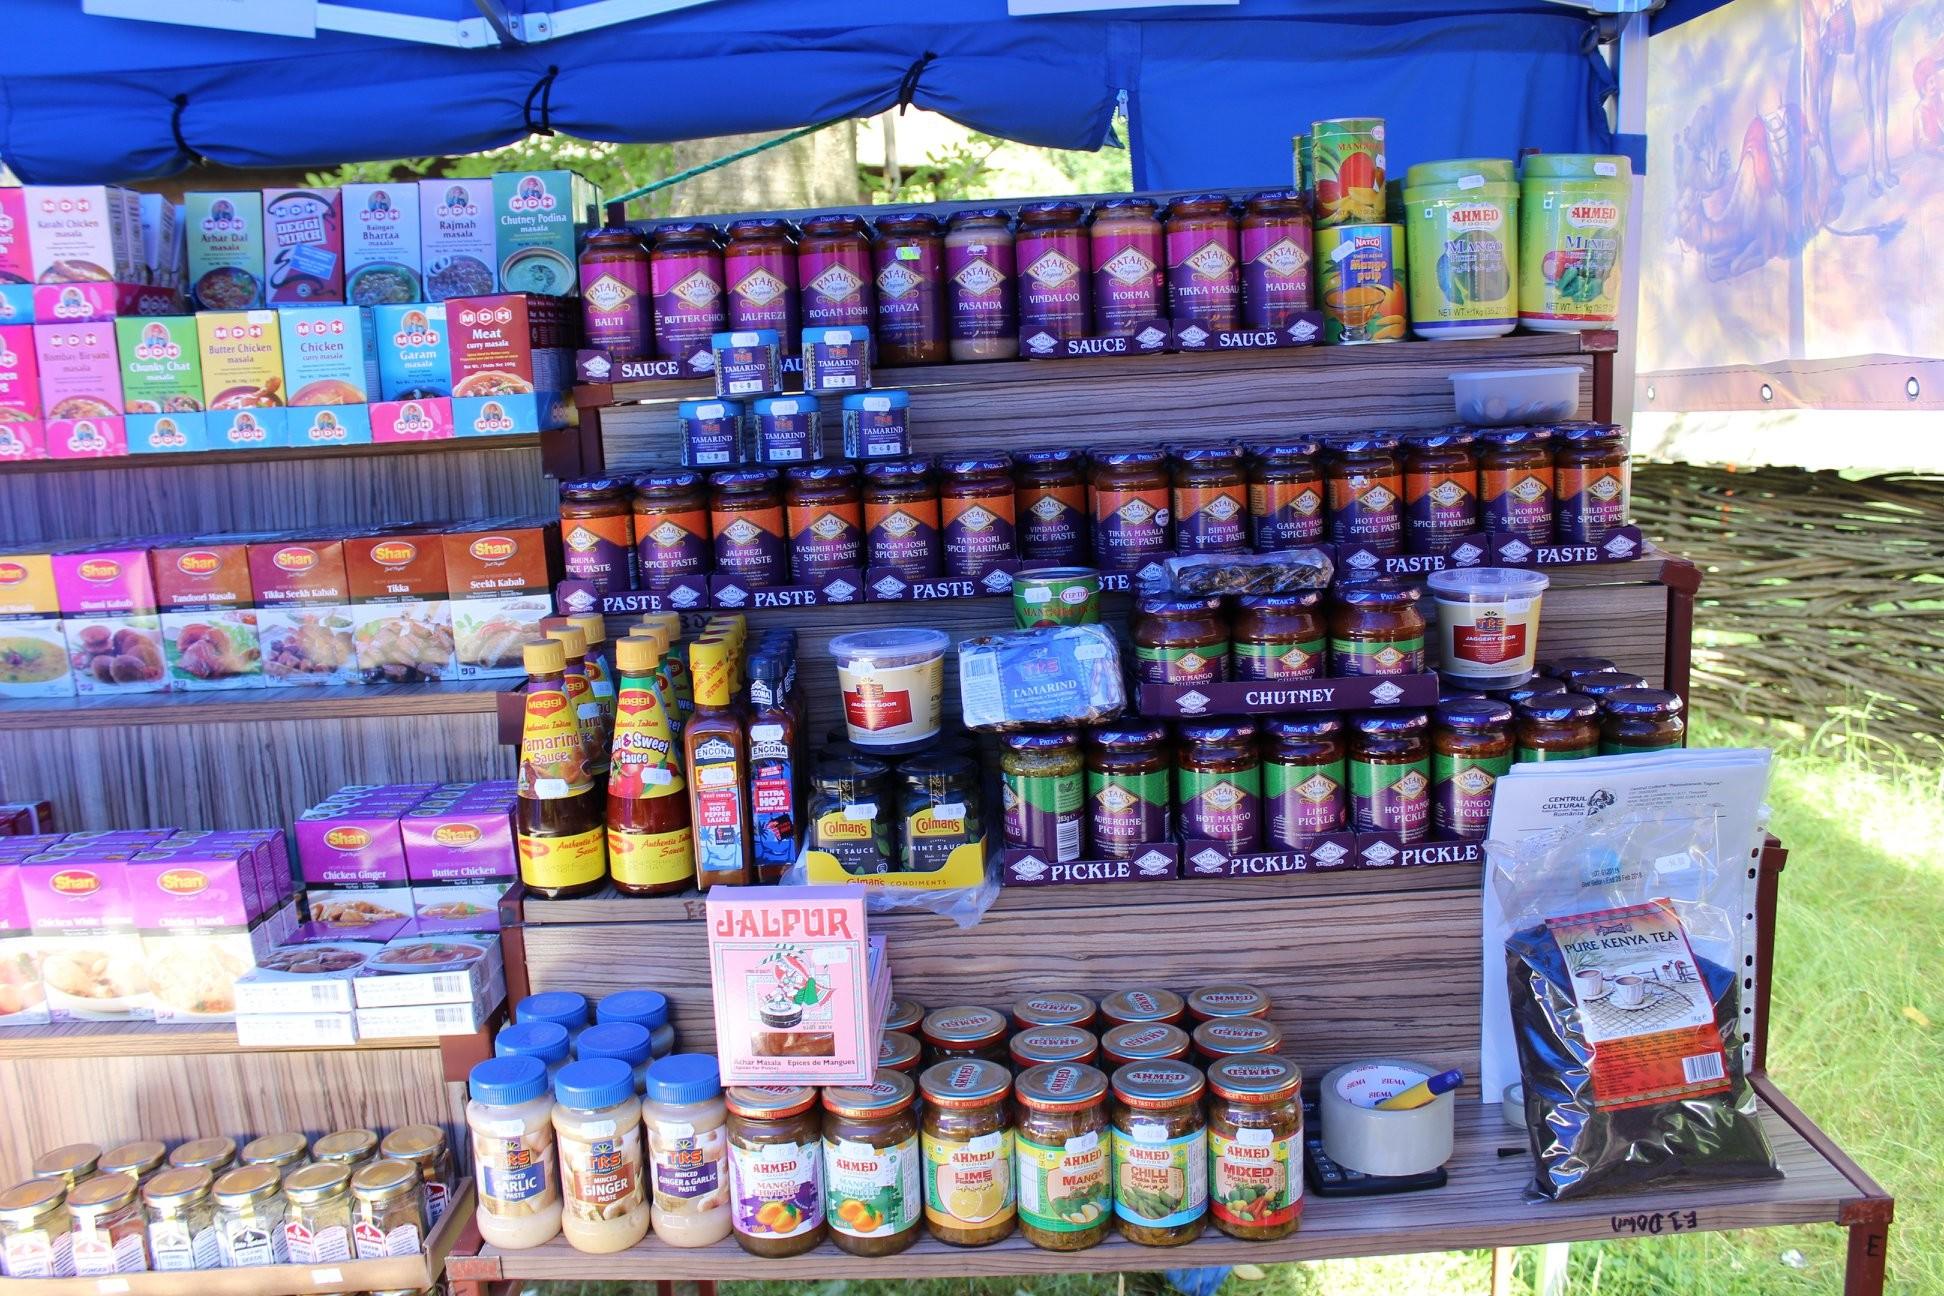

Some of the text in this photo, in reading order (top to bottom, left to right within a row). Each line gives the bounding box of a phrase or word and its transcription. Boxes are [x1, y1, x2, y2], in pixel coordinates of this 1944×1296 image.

[511, 197, 554, 209] MDH
[437, 205, 478, 216] MDH
[1452, 208, 1498, 222] AHMED
[1571, 207, 1617, 219] AHMED
[276, 219, 321, 233] DEGGI
[501, 214, 567, 226] Chutney Podina
[439, 221, 477, 233] Rajmah
[201, 233, 228, 243] Arhar
[278, 231, 322, 246] MIRCH
[363, 231, 400, 240] Bhartaa
[1355, 238, 1380, 248] NATCO
[1566, 236, 1617, 250] MIXED
[1351, 260, 1387, 272] Mango
[1357, 271, 1382, 283] pulp
[1265, 282, 1307, 292] MADRAS
[1029, 293, 1080, 304] VINDALOO
[1113, 290, 1150, 300] KORMA
[879, 303, 919, 313] DOPIAZA
[959, 301, 1002, 311] PASANDA
[461, 309, 511, 325] MDH
[741, 312, 786, 322] JALFREZI
[809, 307, 868, 319] ROGAN JOSH
[297, 321, 345, 335] MDH
[595, 317, 624, 327] BALTI
[215, 326, 263, 338] MDH
[472, 329, 501, 340] Meat
[396, 333, 438, 345] MDH
[1219, 332, 1278, 347] SAUCE
[300, 342, 344, 353] Chicken
[1068, 338, 1127, 354] SAUCE
[400, 351, 437, 361] Garam
[622, 361, 680, 377] SAUCE
[764, 431, 806, 440] TAMARIND
[863, 426, 903, 435] TAMARIND
[692, 435, 733, 444] TAMARIND
[1436, 511, 1460, 519] TIKKA
[1515, 507, 1544, 515] KORMA
[1108, 528, 1164, 538] TIKKA MASALA
[957, 535, 1000, 544] TANDOORI
[1109, 536, 1164, 547] SPICE PASTE
[375, 548, 412, 562] Shan
[475, 543, 512, 557] Shan
[725, 549, 762, 557] JALFREZI
[796, 545, 834, 553] KASHMIRI
[875, 548, 928, 559] SPICE PASTE
[1537, 547, 1599, 563] PASTE
[277, 553, 312, 567] Shan
[719, 556, 772, 566] SPICE PASTE
[803, 550, 857, 562] SPICE PASTE
[182, 556, 217, 570] Shan
[644, 558, 698, 569] SPICE PASTE
[1386, 556, 1446, 572] PASTE
[387, 584, 410, 593] Tikka
[470, 578, 525, 589] Seekh Kabab
[913, 581, 975, 598] PASTE
[172, 592, 237, 603] Tandoori Masala
[755, 590, 816, 607] PASTE
[603, 596, 661, 612] PASTE
[1170, 672, 1213, 682] HOT MANGO
[1273, 668, 1315, 679] HOT MANGO
[1012, 680, 1077, 698] TAMARIND
[1245, 688, 1335, 706] CHUTNEY
[527, 698, 562, 710] Maggi
[551, 720, 572, 730] Indian
[637, 719, 659, 729] Indian
[523, 733, 580, 750] Tamarind
[697, 747, 734, 758] ENCONA
[753, 746, 786, 756] ENCONA
[533, 752, 568, 764] Sauce
[621, 752, 649, 764] Sauce
[760, 797, 785, 807] HOT
[1455, 799, 1491, 808] MANGO
[1306, 807, 1328, 815] LIME
[1453, 808, 1492, 817] PICKLE
[1095, 815, 1141, 826] AUBERGINE
[1196, 812, 1250, 823] HOT MANGO
[1298, 815, 1335, 826] PICKLE
[824, 821, 867, 837] Colman's
[916, 817, 960, 834] Colman's
[1098, 826, 1135, 836] PICKLE
[1205, 823, 1243, 833] PICKLE
[328, 832, 367, 846] Shan
[436, 829, 475, 842] Shan
[557, 838, 592, 851] Authentic
[641, 838, 676, 850] Authentic
[1401, 844, 1479, 866] PICKLE
[1231, 854, 1307, 876] PICKLE
[323, 870, 386, 882] Chicken Ginger
[432, 867, 496, 878] Butter Chicken
[1051, 862, 1131, 881] PICKLE
[890, 879, 947, 887] CONDIMENTS
[716, 908, 853, 939] JALPUR
[1564, 931, 1678, 954] PURE KENYA TEA
[788, 1059, 811, 1068] Epices
[824, 1059, 856, 1067] Mangues
[668, 1151, 702, 1165] TRS
[952, 1151, 995, 1164] AHMED
[1064, 1149, 1102, 1166] AHMED
[1129, 1149, 1169, 1160] AHMED
[1227, 1145, 1270, 1159] AHMED
[589, 1152, 622, 1169] TRS
[837, 1159, 878, 1172] AHMED
[753, 1160, 797, 1174] AHMED
[1131, 1166, 1169, 1178] CHILLI
[1223, 1164, 1274, 1177] MIXED
[594, 1175, 618, 1183] MINCED
[675, 1171, 698, 1179] MINCED
[954, 1169, 992, 1181] LIME
[494, 1177, 537, 1192] GARLIC
[584, 1178, 629, 1196] GINGER
[678, 1185, 697, 1193] PASTE
[598, 1194, 617, 1202] PASTE
[1867, 1235, 1883, 1257] E
